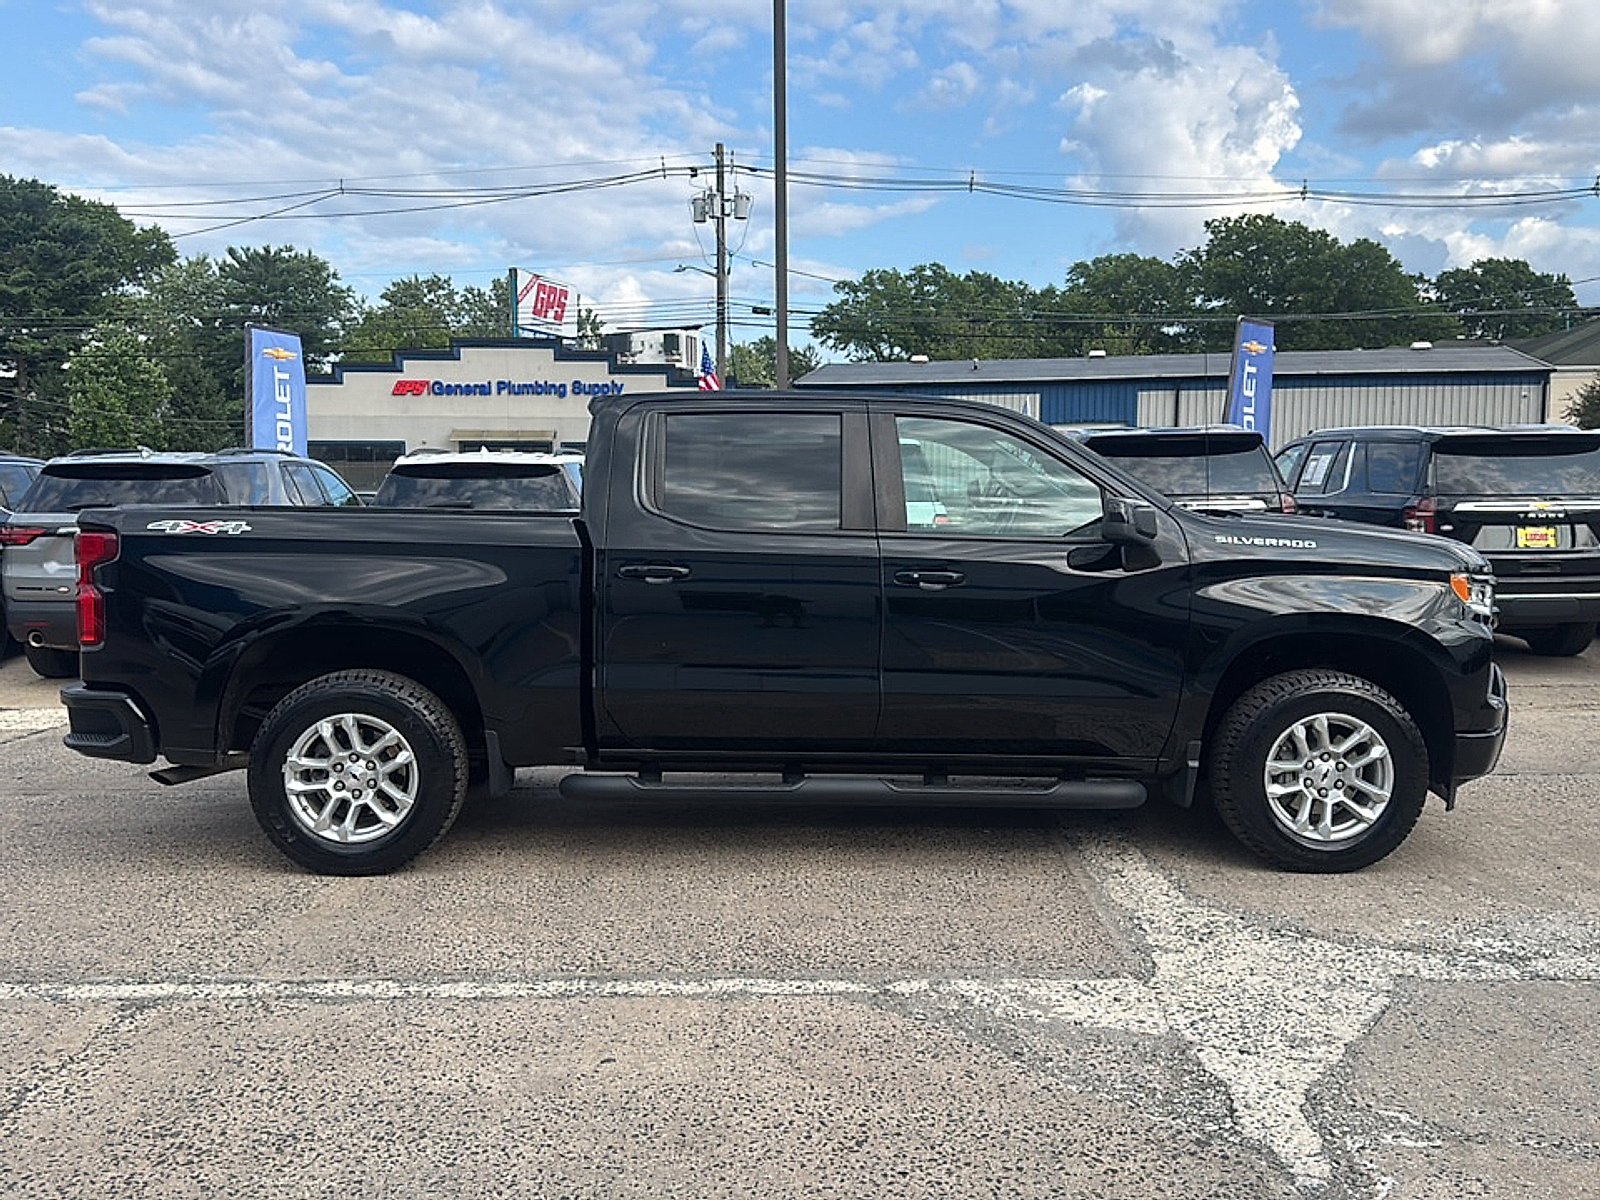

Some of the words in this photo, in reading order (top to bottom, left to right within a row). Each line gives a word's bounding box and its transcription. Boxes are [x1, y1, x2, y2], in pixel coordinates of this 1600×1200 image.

[532, 283, 569, 322] GPS
[392, 380, 430, 396] GPS
[431, 380, 492, 396] General
[496, 380, 568, 399] Plumbing
[571, 380, 625, 396] Supply
[1214, 536, 1317, 549] SILVERADO
